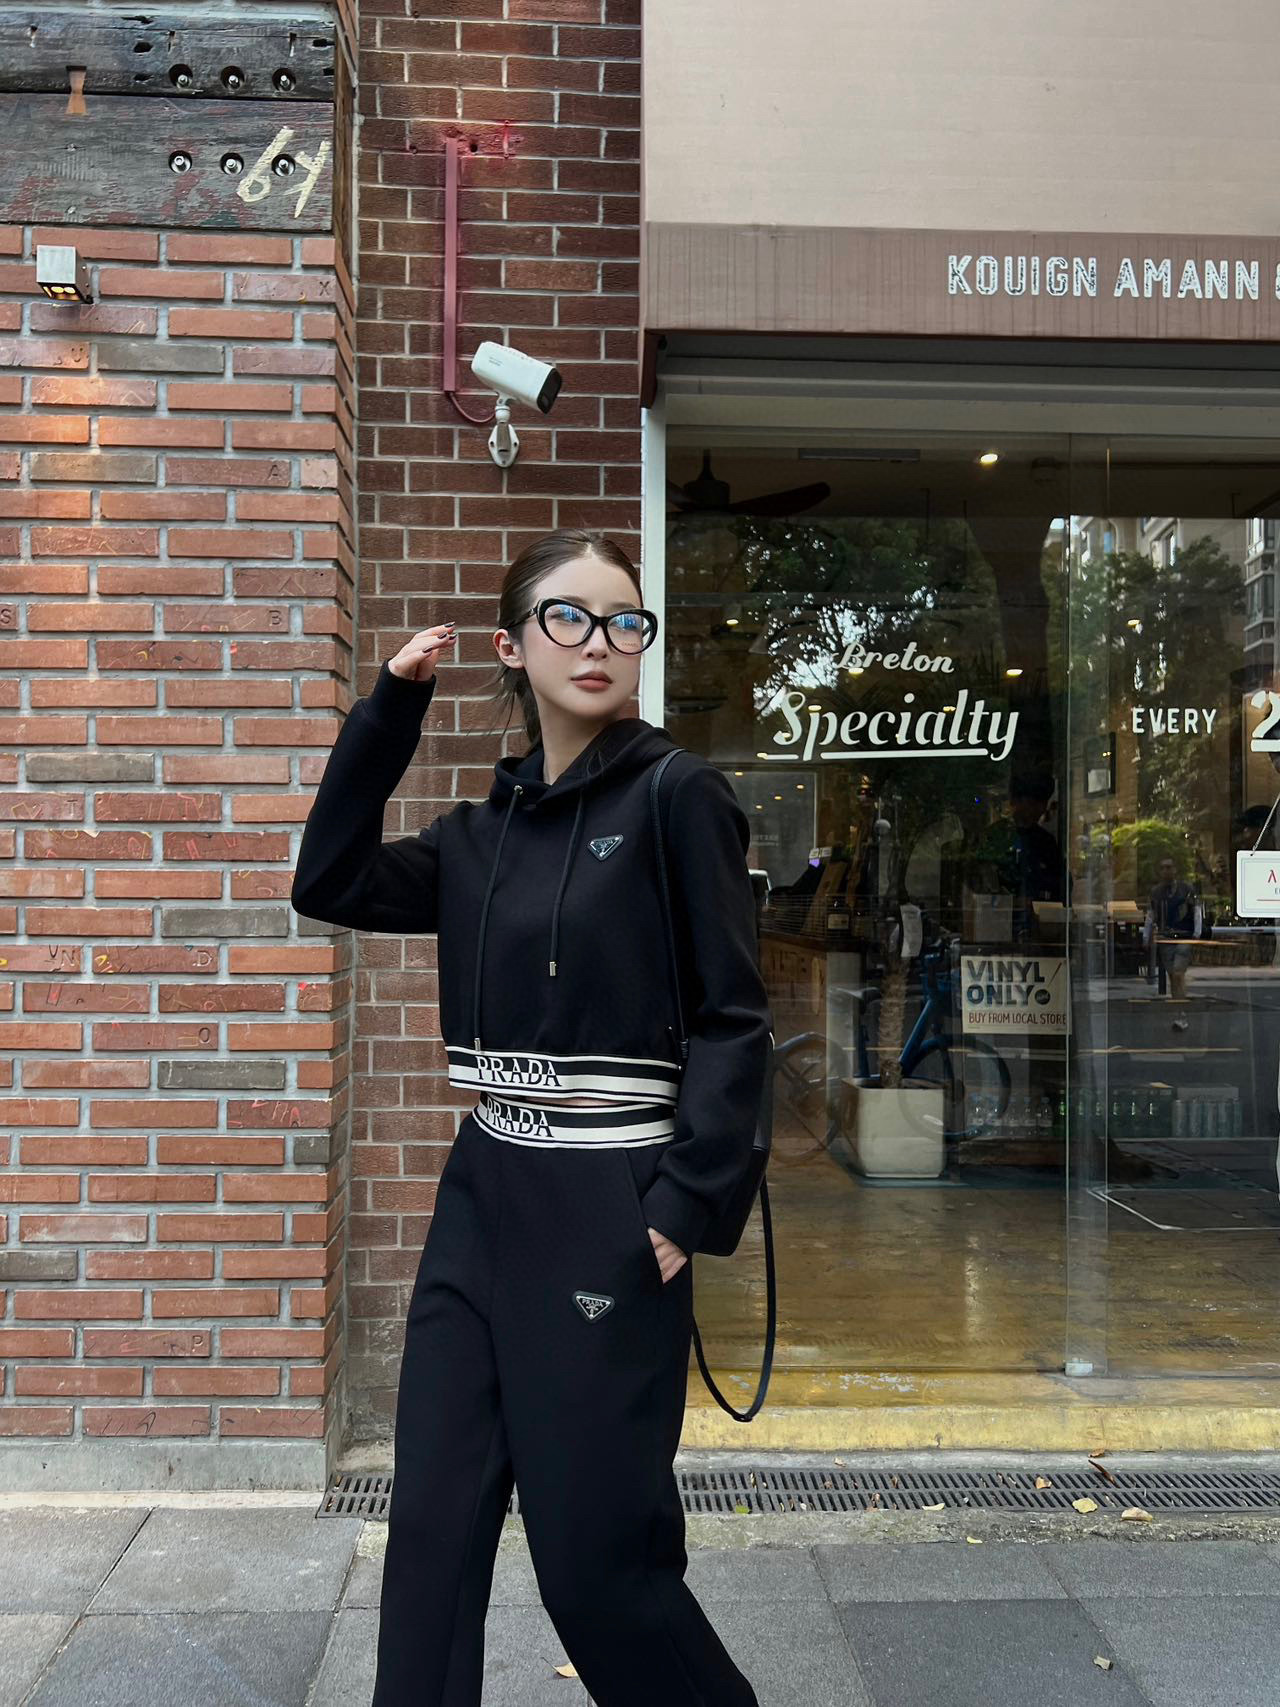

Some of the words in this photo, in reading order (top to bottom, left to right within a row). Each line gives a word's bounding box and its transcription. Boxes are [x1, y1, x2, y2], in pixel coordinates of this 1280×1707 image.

[948, 255, 1097, 297] KOUIGN
[1113, 257, 1259, 300] AMANN
[832, 641, 955, 674] Breton
[773, 688, 1020, 761] Specialty
[1132, 707, 1217, 734] EVERY
[967, 960, 1045, 983] VINYL
[967, 984, 1035, 1005] ONLY
[968, 1012, 986, 1024] BUY
[988, 1012, 1010, 1024] FROM
[1012, 1012, 1038, 1025] LOCAL
[475, 1055, 562, 1087] PRADA
[486, 1096, 554, 1138] PRADA
